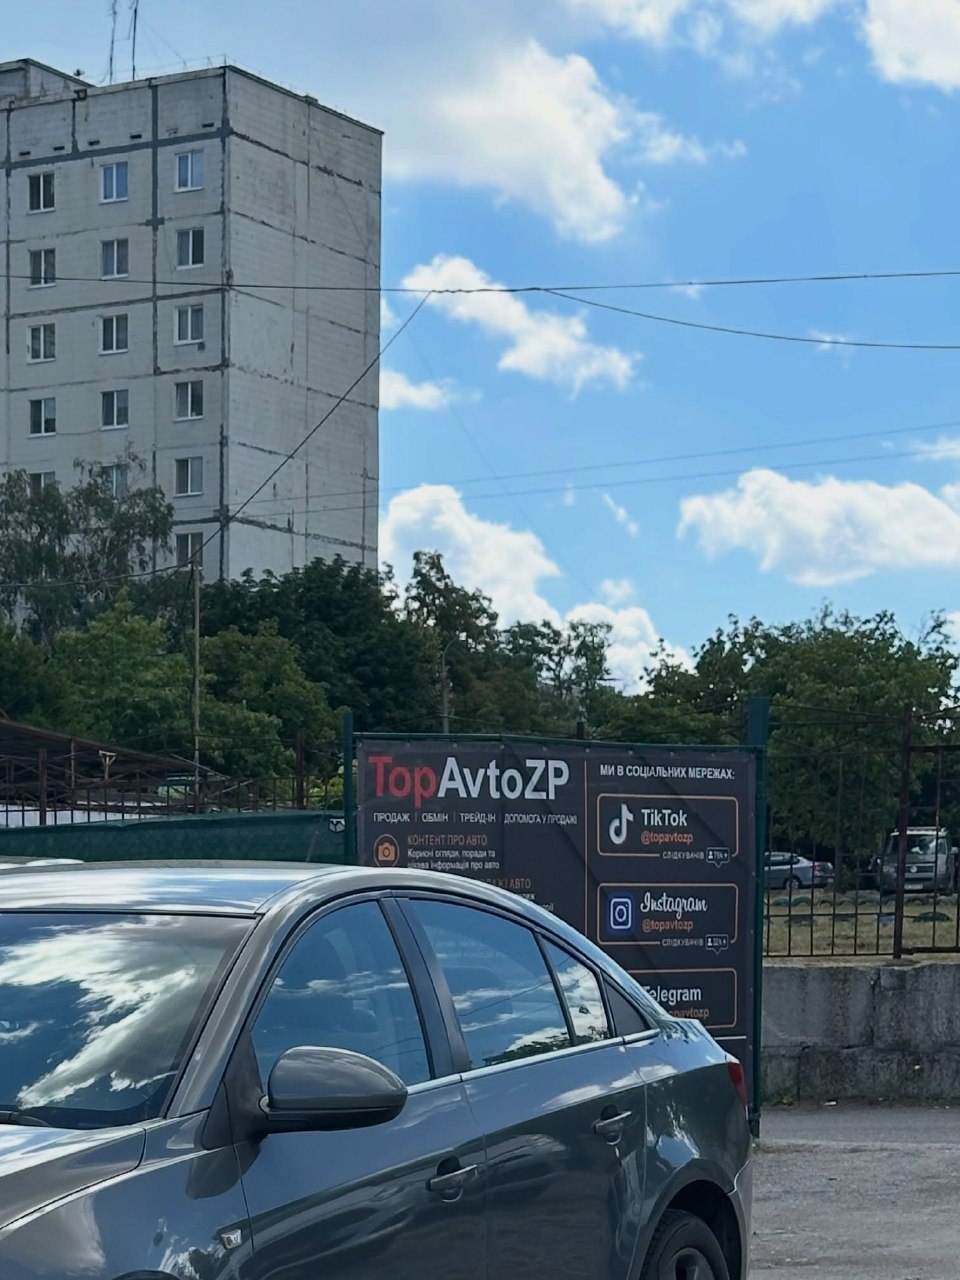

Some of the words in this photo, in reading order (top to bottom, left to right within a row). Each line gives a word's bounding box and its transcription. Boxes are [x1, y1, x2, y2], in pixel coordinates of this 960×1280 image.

[600, 764, 615, 776] МИ
[617, 765, 624, 776] В
[626, 765, 687, 778] СОЦІАЛЬНИХ
[689, 767, 735, 780] МЕРЕЖАХ:
[368, 756, 570, 808] TopAvtoZP
[373, 812, 410, 824] ПРОДАЖ
[421, 812, 449, 823] ОБМІН
[641, 808, 688, 826] TikTok
[407, 834, 445, 846] КОНТЕНТ
[447, 834, 465, 846] ПРО
[466, 834, 488, 846] АВТО
[640, 831, 694, 844] @topavtozp
[640, 892, 708, 920] Instagram
[642, 919, 694, 933] @topavtozp
